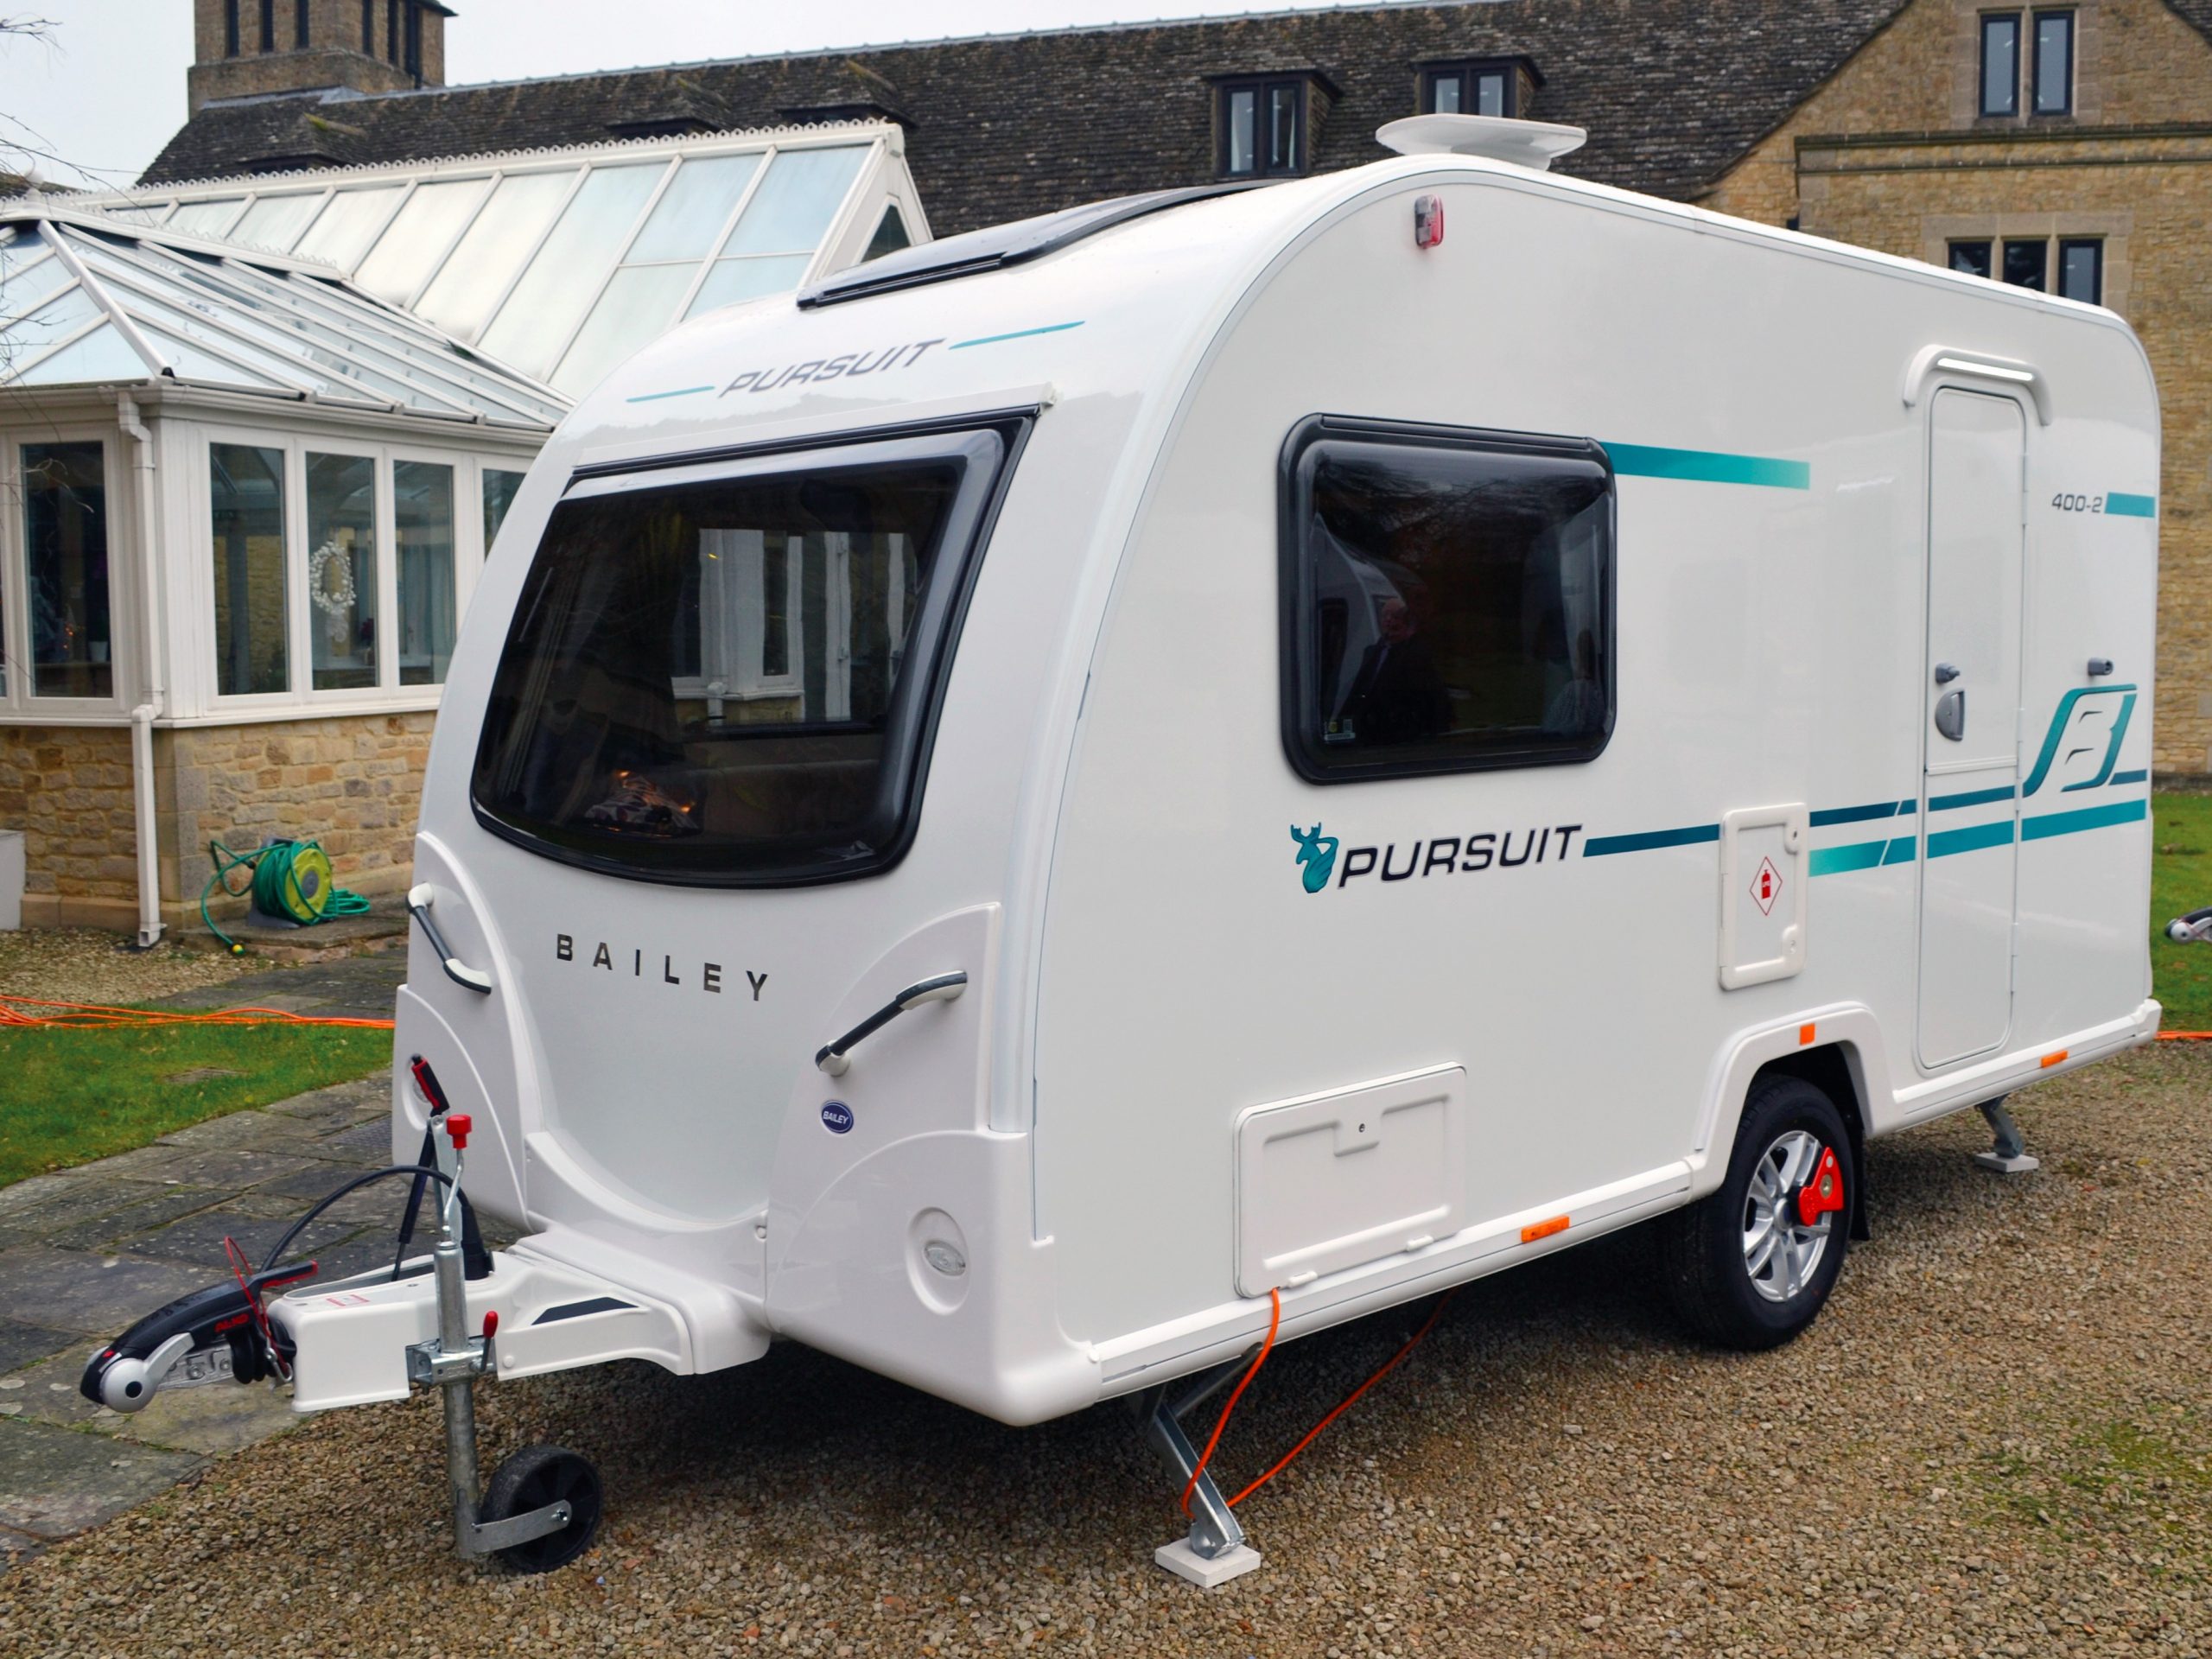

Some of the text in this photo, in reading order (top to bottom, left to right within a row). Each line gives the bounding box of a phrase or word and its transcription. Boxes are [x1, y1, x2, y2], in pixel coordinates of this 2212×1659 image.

[719, 338, 946, 397] PURSUIT
[2051, 493, 2102, 513] 400-2
[1338, 823, 1582, 888] PURSUIT
[556, 933, 768, 1001] BAILEY
[823, 1110, 849, 1124] BAILEY
